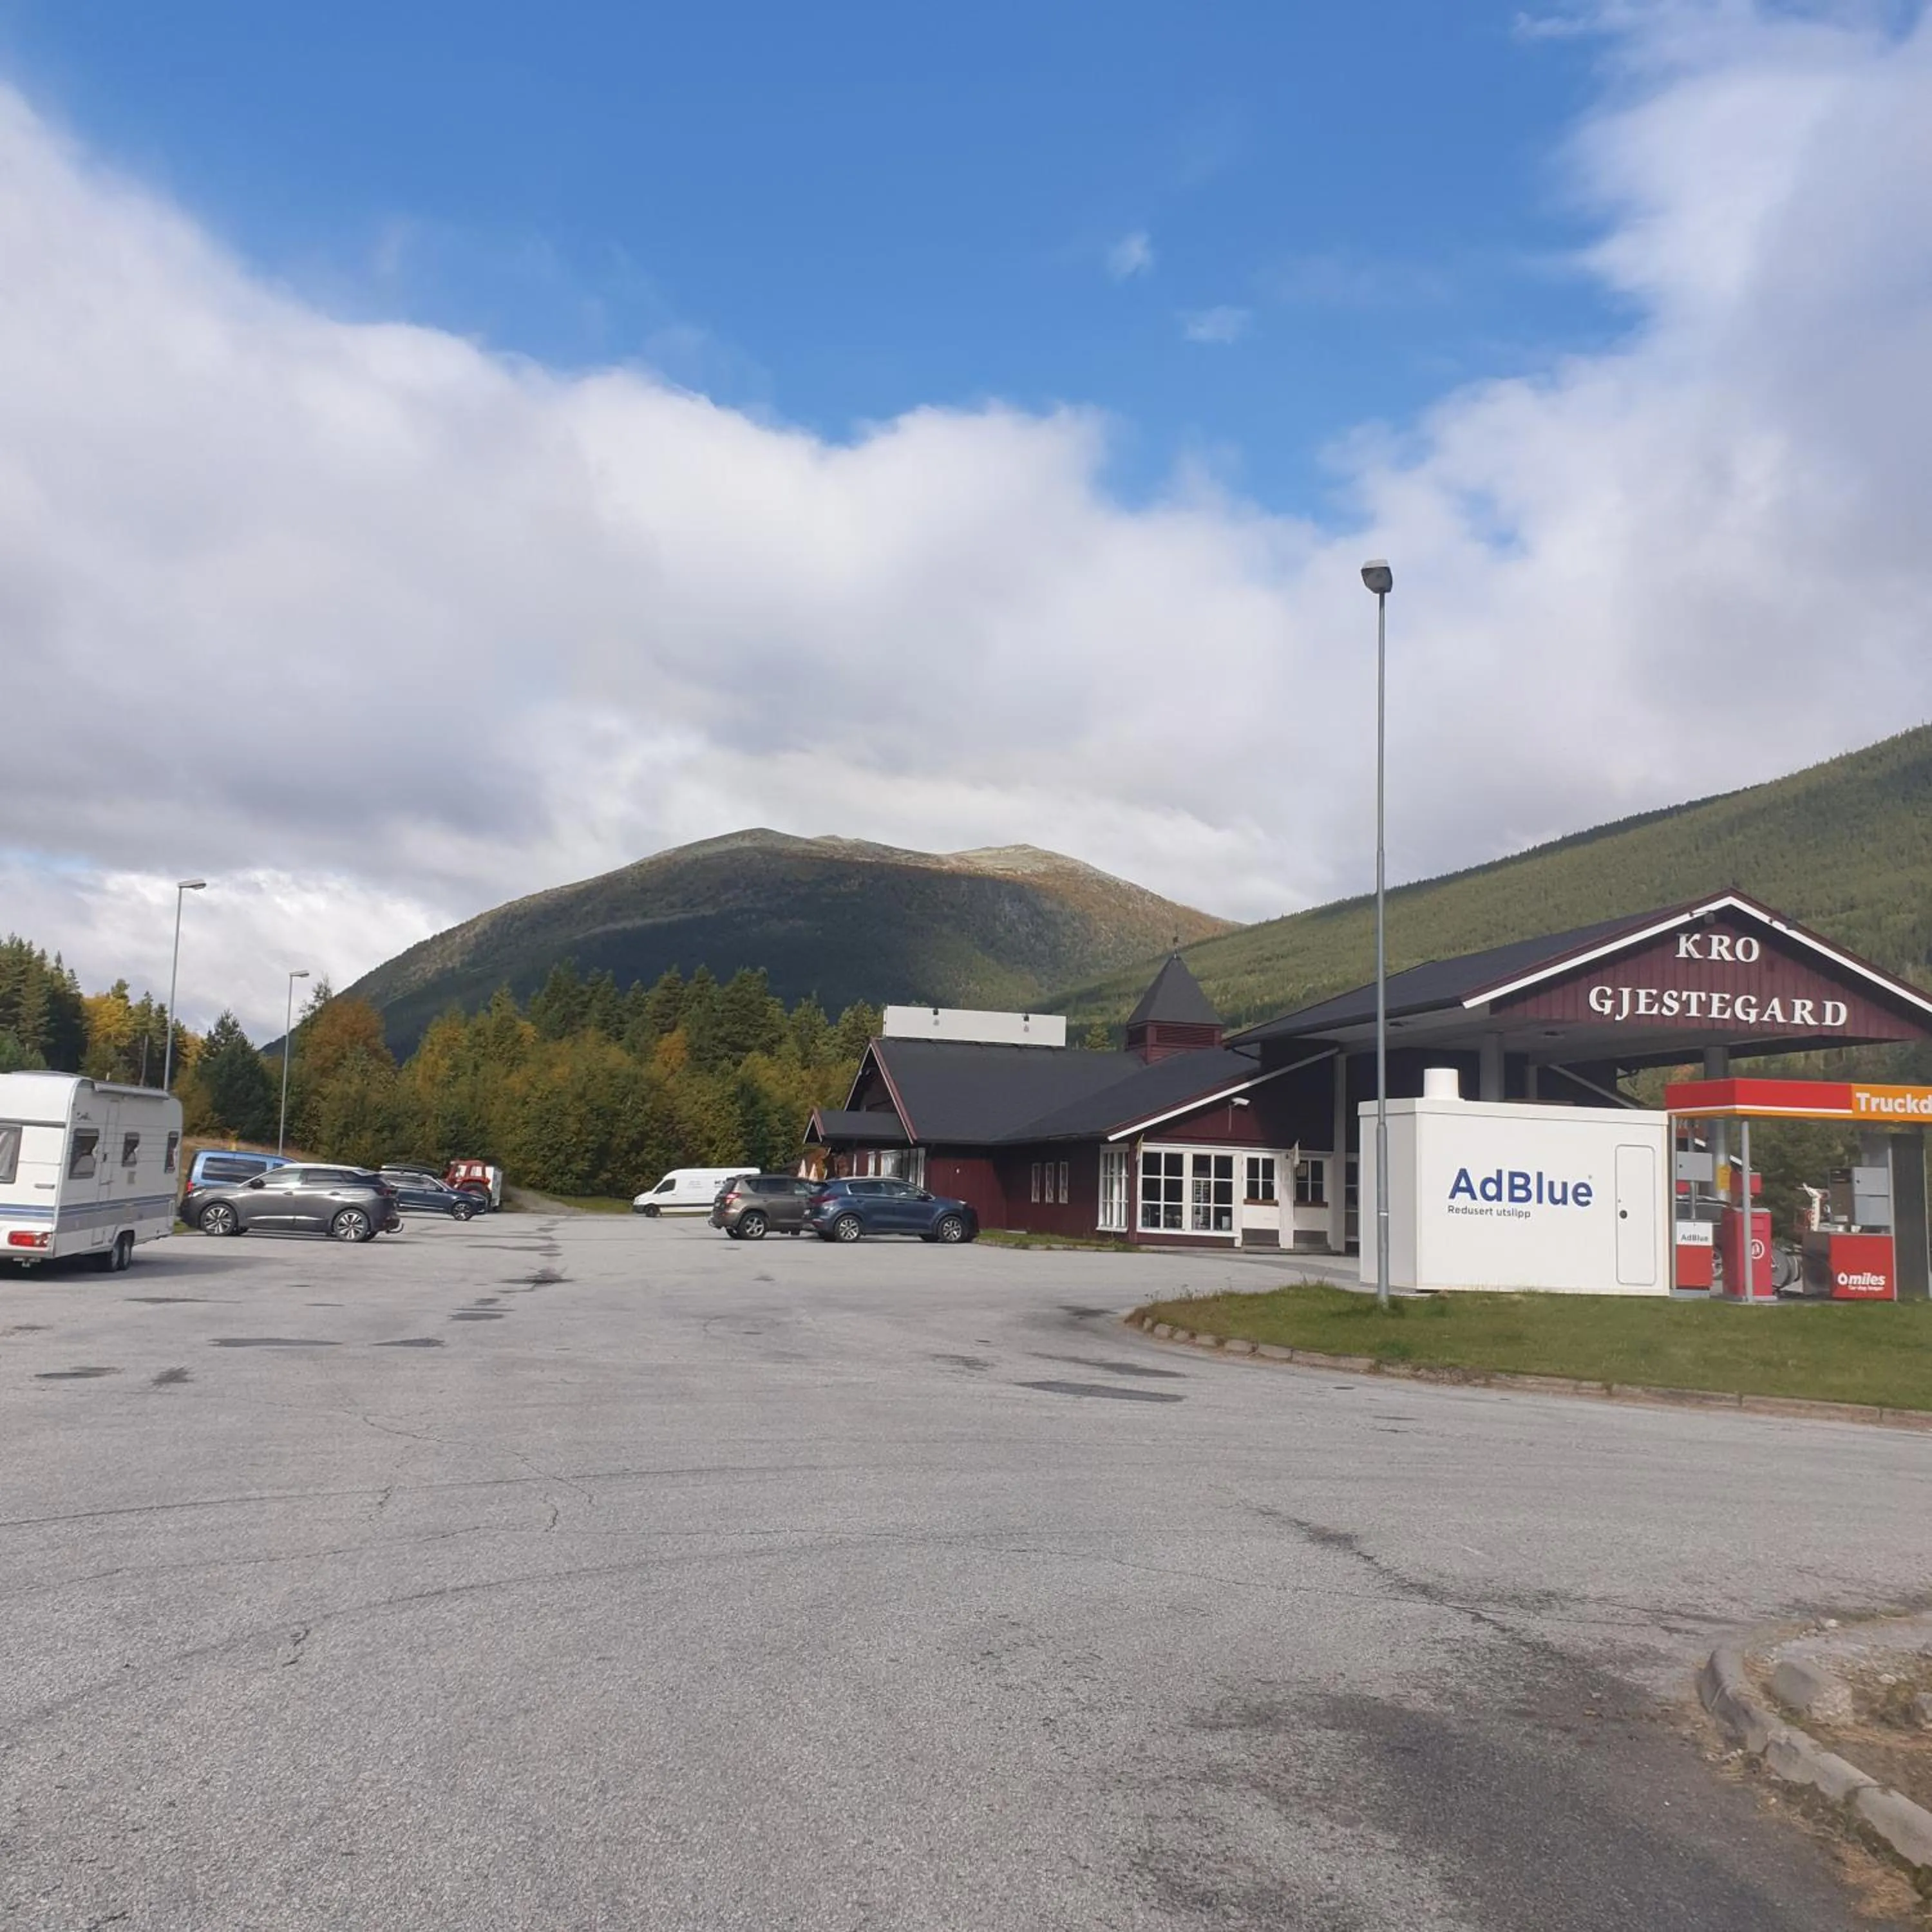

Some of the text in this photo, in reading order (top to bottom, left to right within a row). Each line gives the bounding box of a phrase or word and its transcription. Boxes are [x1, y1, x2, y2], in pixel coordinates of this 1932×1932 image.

[1675, 933, 1760, 963] KRO
[1588, 985, 1848, 1027] GJESTEGARD
[1448, 1167, 1593, 1208] AdBlue
[1447, 1205, 1531, 1219] Redusert utslipp
[1680, 1233, 1709, 1242] AdBlue
[1848, 1272, 1886, 1286] miles
